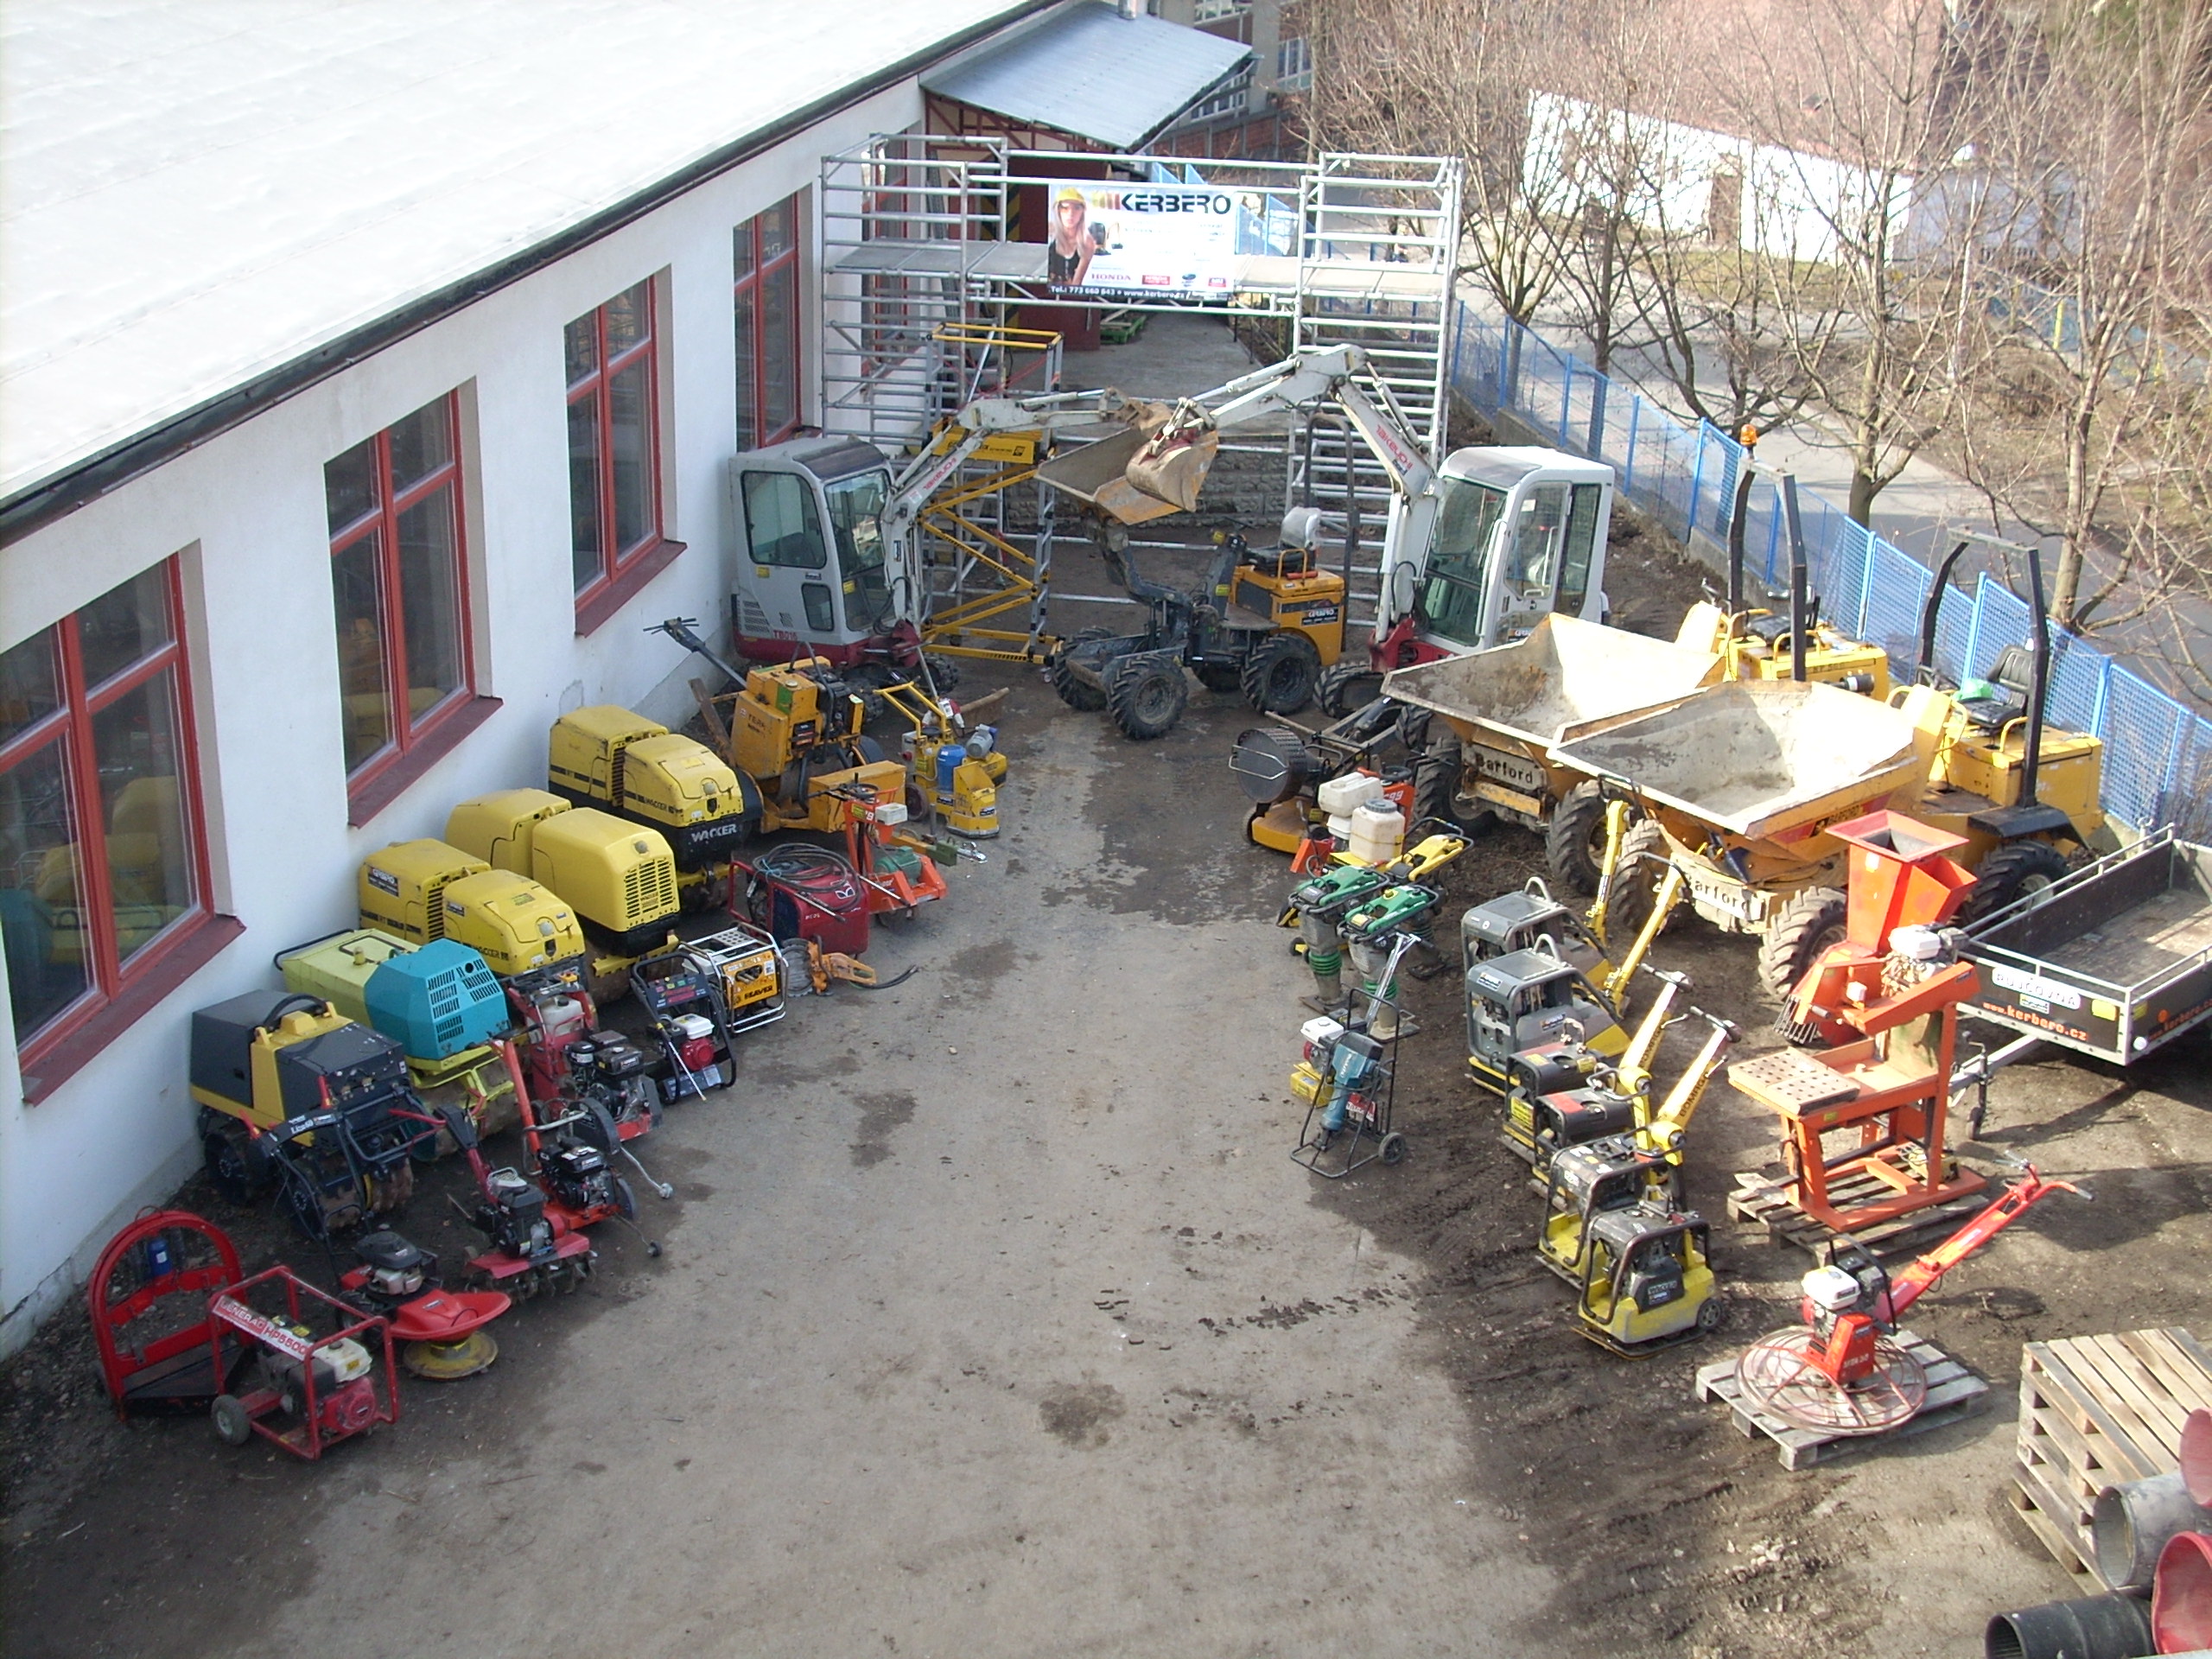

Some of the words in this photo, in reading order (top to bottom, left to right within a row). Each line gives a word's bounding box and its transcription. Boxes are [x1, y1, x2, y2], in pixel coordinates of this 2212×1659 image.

[1122, 194, 1231, 215] KERBERO
[690, 823, 738, 843] WACKER
[1689, 875, 1750, 913] arford
[1982, 1001, 2088, 1041] www.kerbero.cz
[1679, 1076, 1707, 1117] BOMAG
